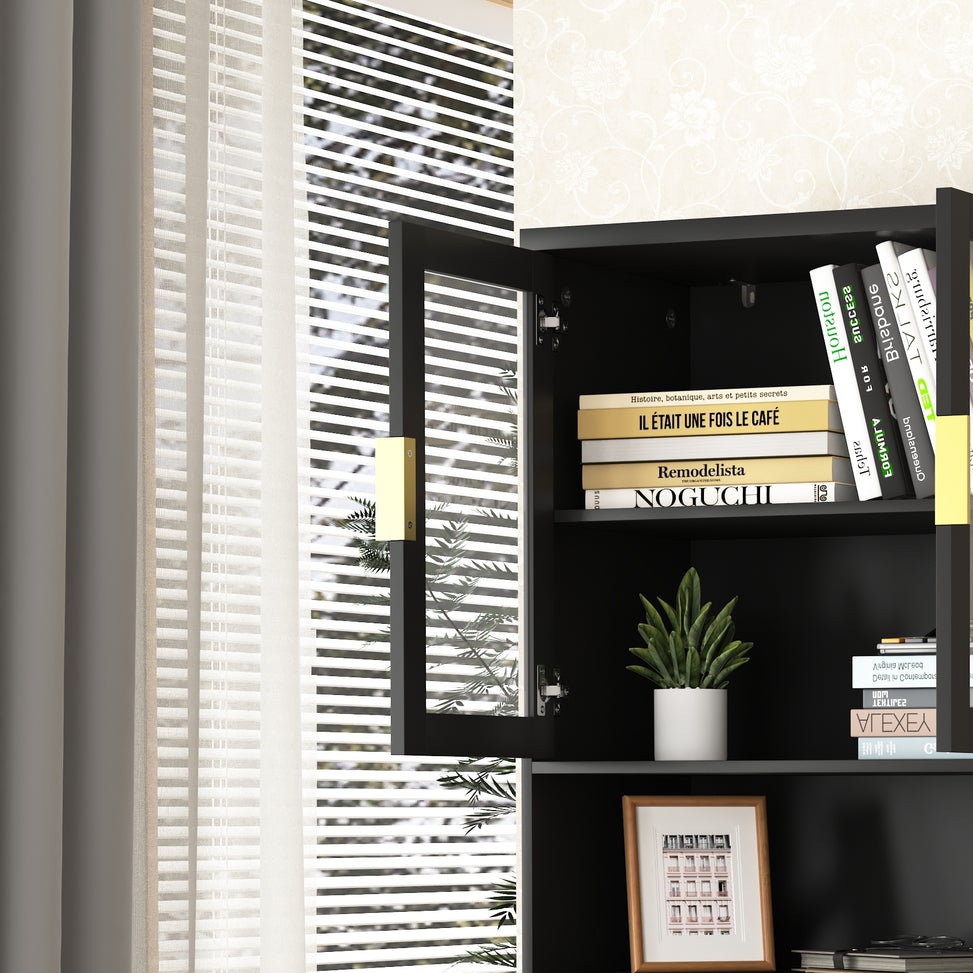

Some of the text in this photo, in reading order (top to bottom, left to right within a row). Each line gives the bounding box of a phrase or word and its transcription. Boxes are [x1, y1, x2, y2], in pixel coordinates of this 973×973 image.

[630, 390, 788, 404] Histoire, botanique, arts et petits secrets
[639, 407, 780, 431] IL ÉTAIT UNE FOIS LE CAFÉ
[657, 463, 746, 479] Remodelista
[634, 485, 773, 509] NOGUCHI
